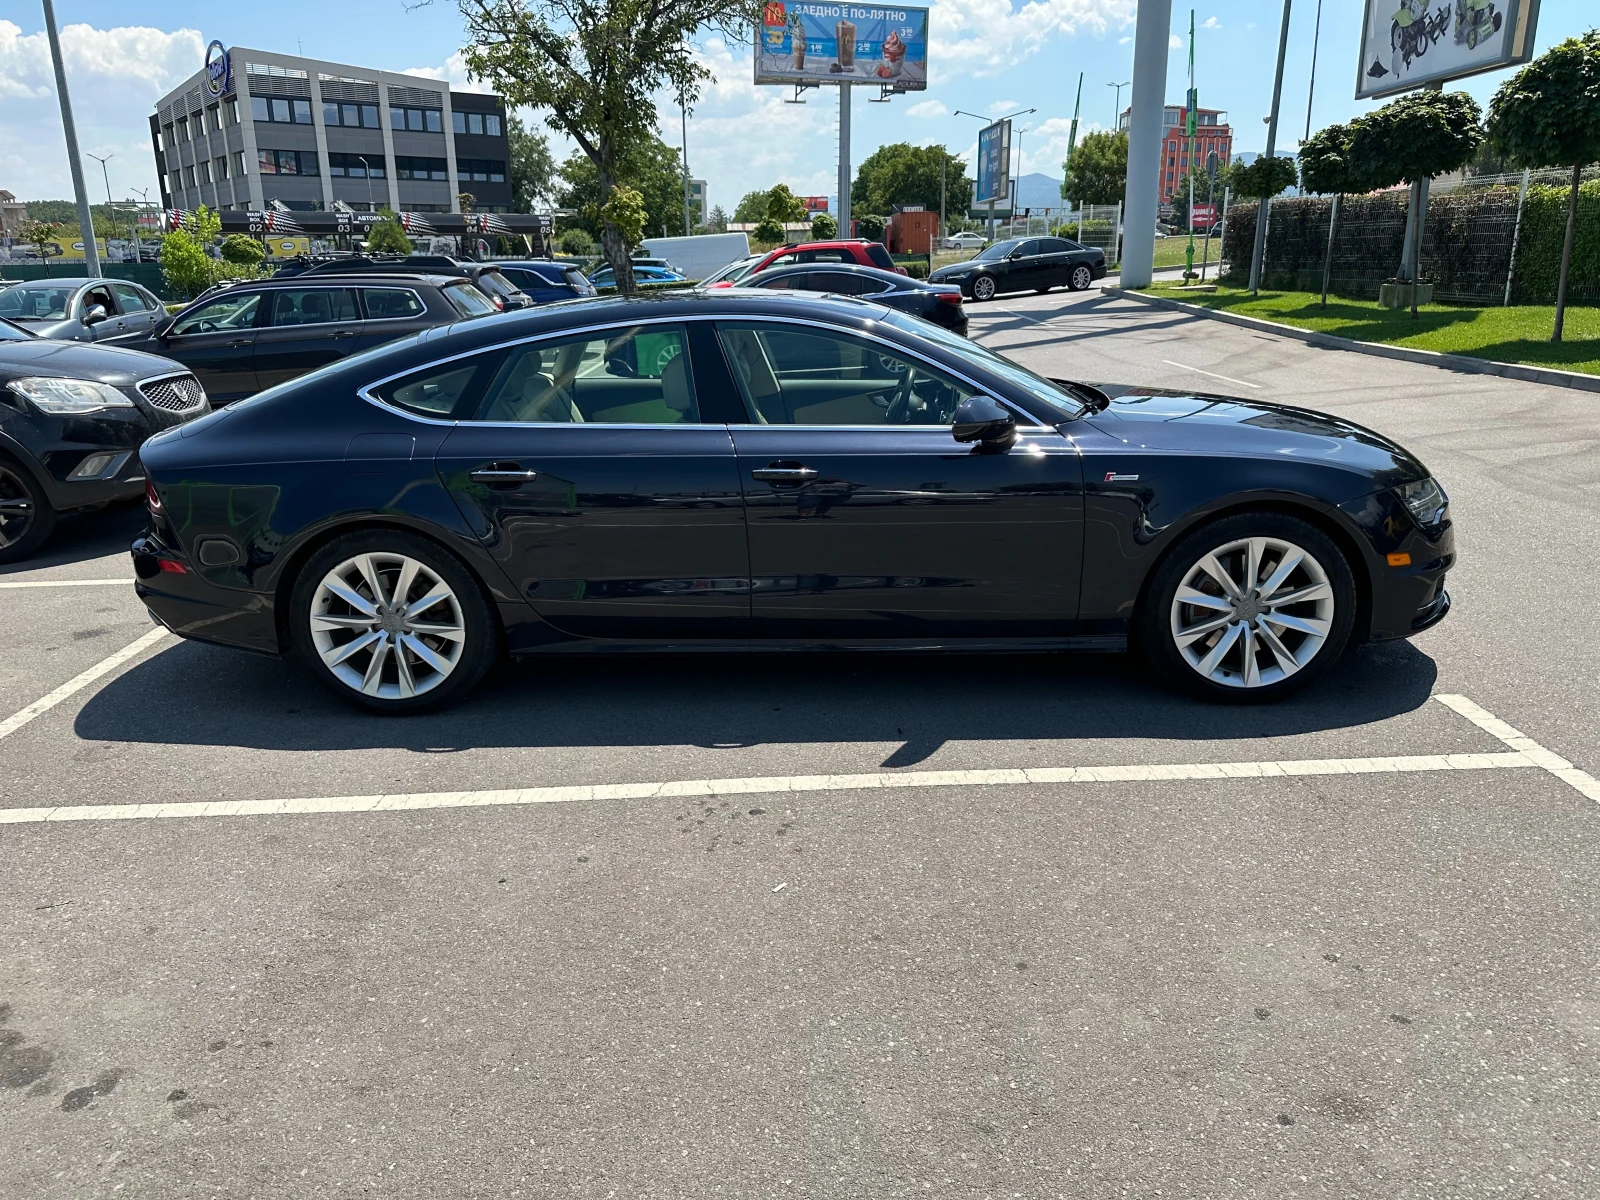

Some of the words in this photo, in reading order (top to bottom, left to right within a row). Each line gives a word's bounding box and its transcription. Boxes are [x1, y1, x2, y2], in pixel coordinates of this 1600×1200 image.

[796, 4, 840, 18] ЗАЕДНО
[850, 8, 906, 22] ПО-ЛЯТНО
[249, 224, 262, 232] 02
